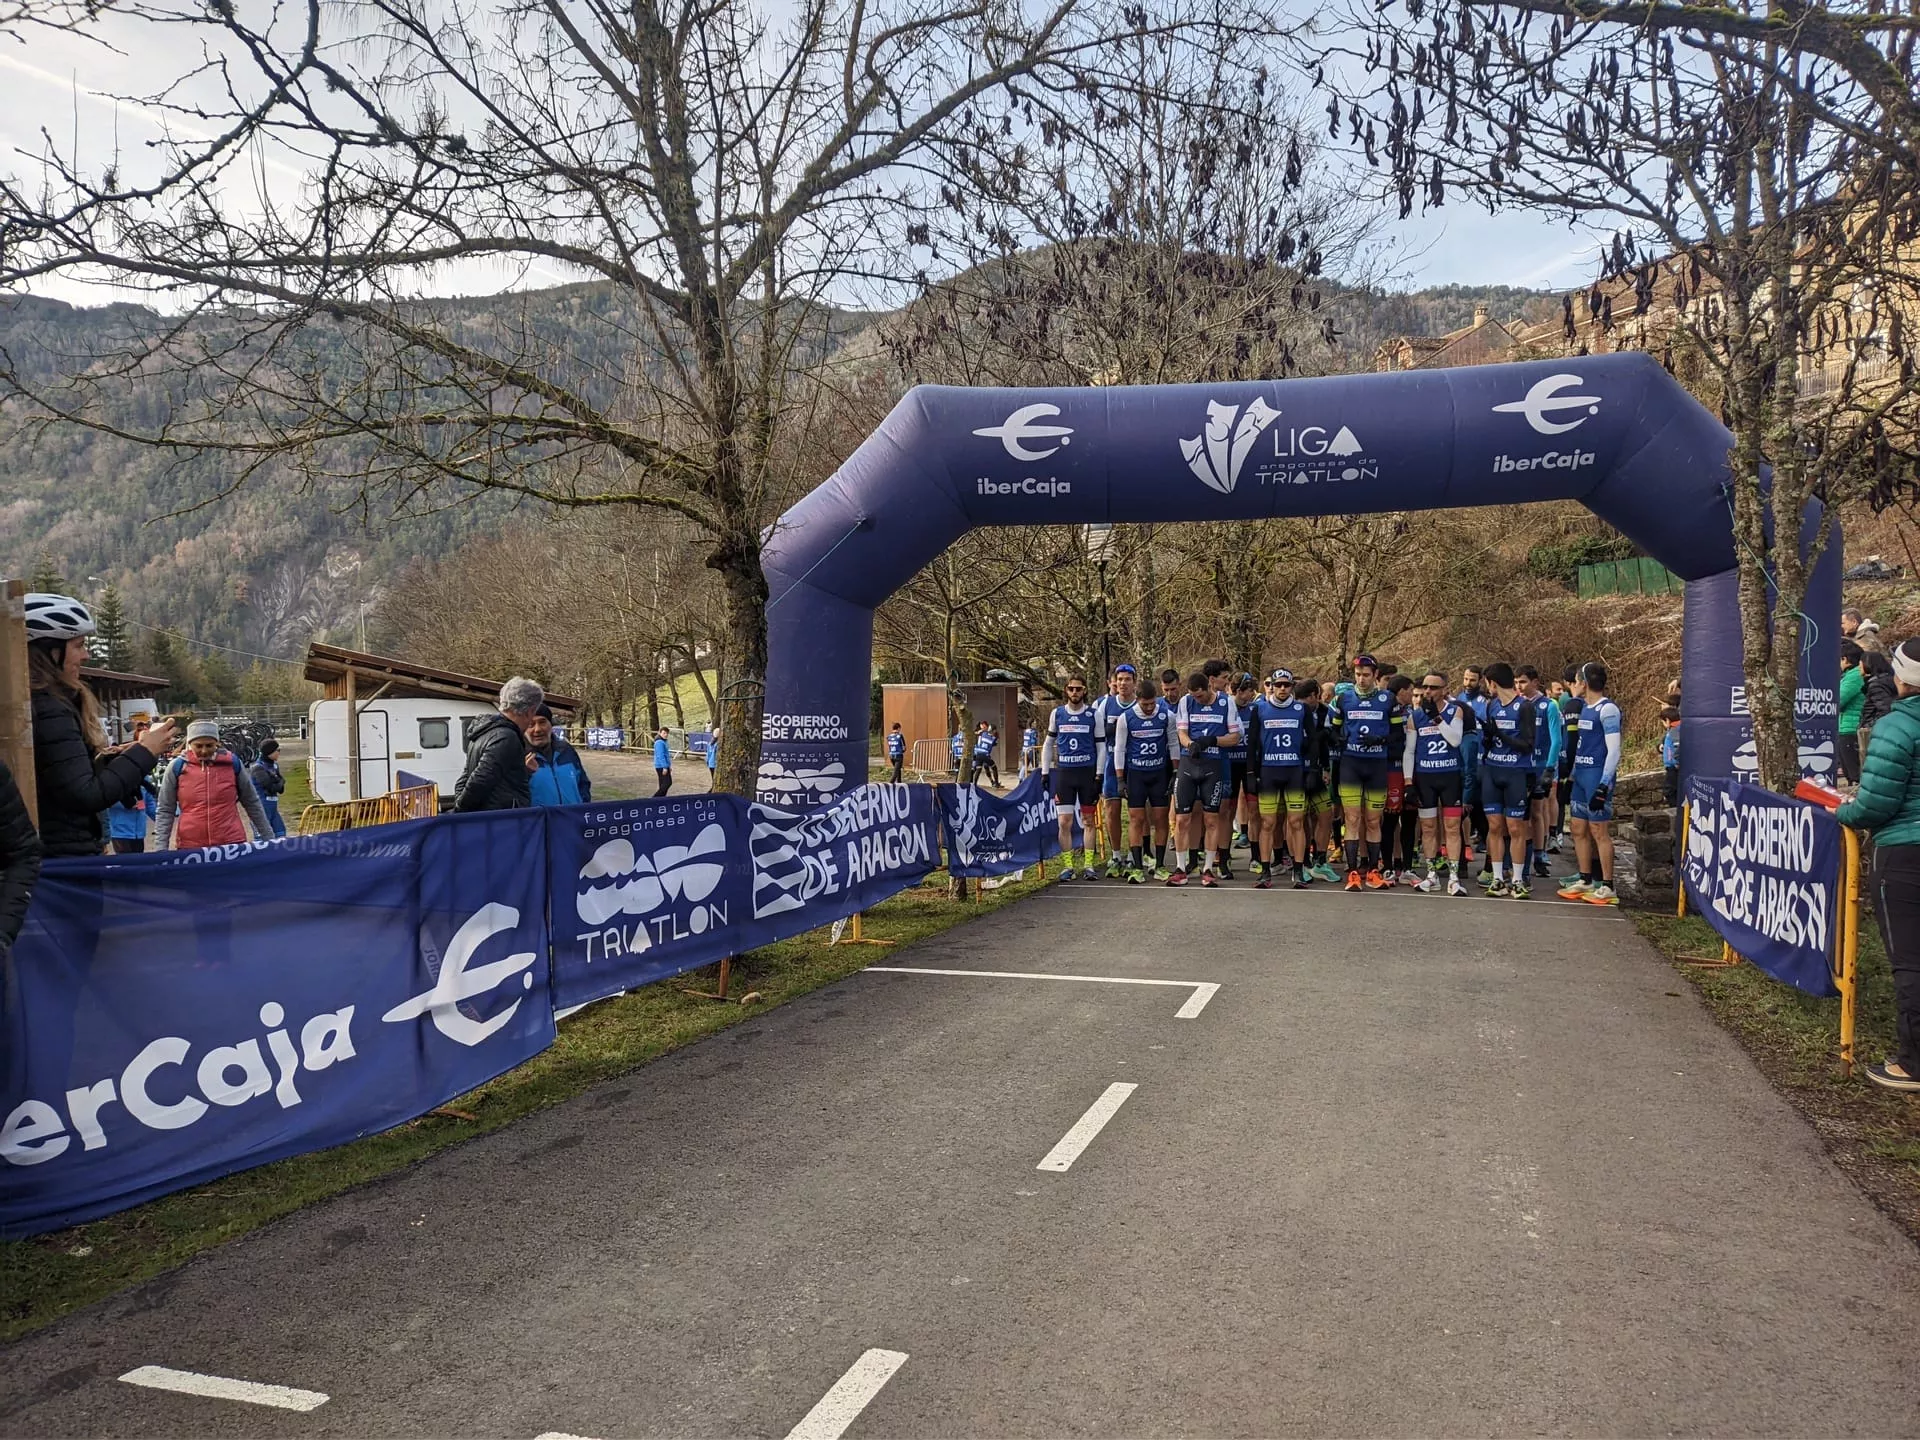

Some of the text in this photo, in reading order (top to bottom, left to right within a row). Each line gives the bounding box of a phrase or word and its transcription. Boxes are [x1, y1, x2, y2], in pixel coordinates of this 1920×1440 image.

[1274, 425, 1363, 457] LIGA
[1260, 460, 1346, 470] aragonesa
[1493, 449, 1595, 473] iberCaja
[1255, 467, 1379, 485] TRIATLON
[977, 477, 1071, 498] iberCaja
[771, 715, 840, 728] GOBIERNO
[771, 727, 848, 739] DE ARAGON
[1069, 738, 1078, 750] 9
[1273, 734, 1292, 747] 13
[1140, 742, 1158, 755] 23
[1427, 740, 1448, 754] 22
[1420, 758, 1458, 768] MAYENCOS
[584, 798, 716, 824] federación
[799, 783, 911, 848] GOBIERNO
[584, 810, 716, 838] aragonesa de
[1735, 804, 1814, 874] GOBIERNO
[802, 822, 930, 900] DE ARAGON
[1733, 868, 1827, 952] DE ARAGON
[576, 899, 728, 963] TRIATLON
[0, 1001, 356, 1166] erCaja
